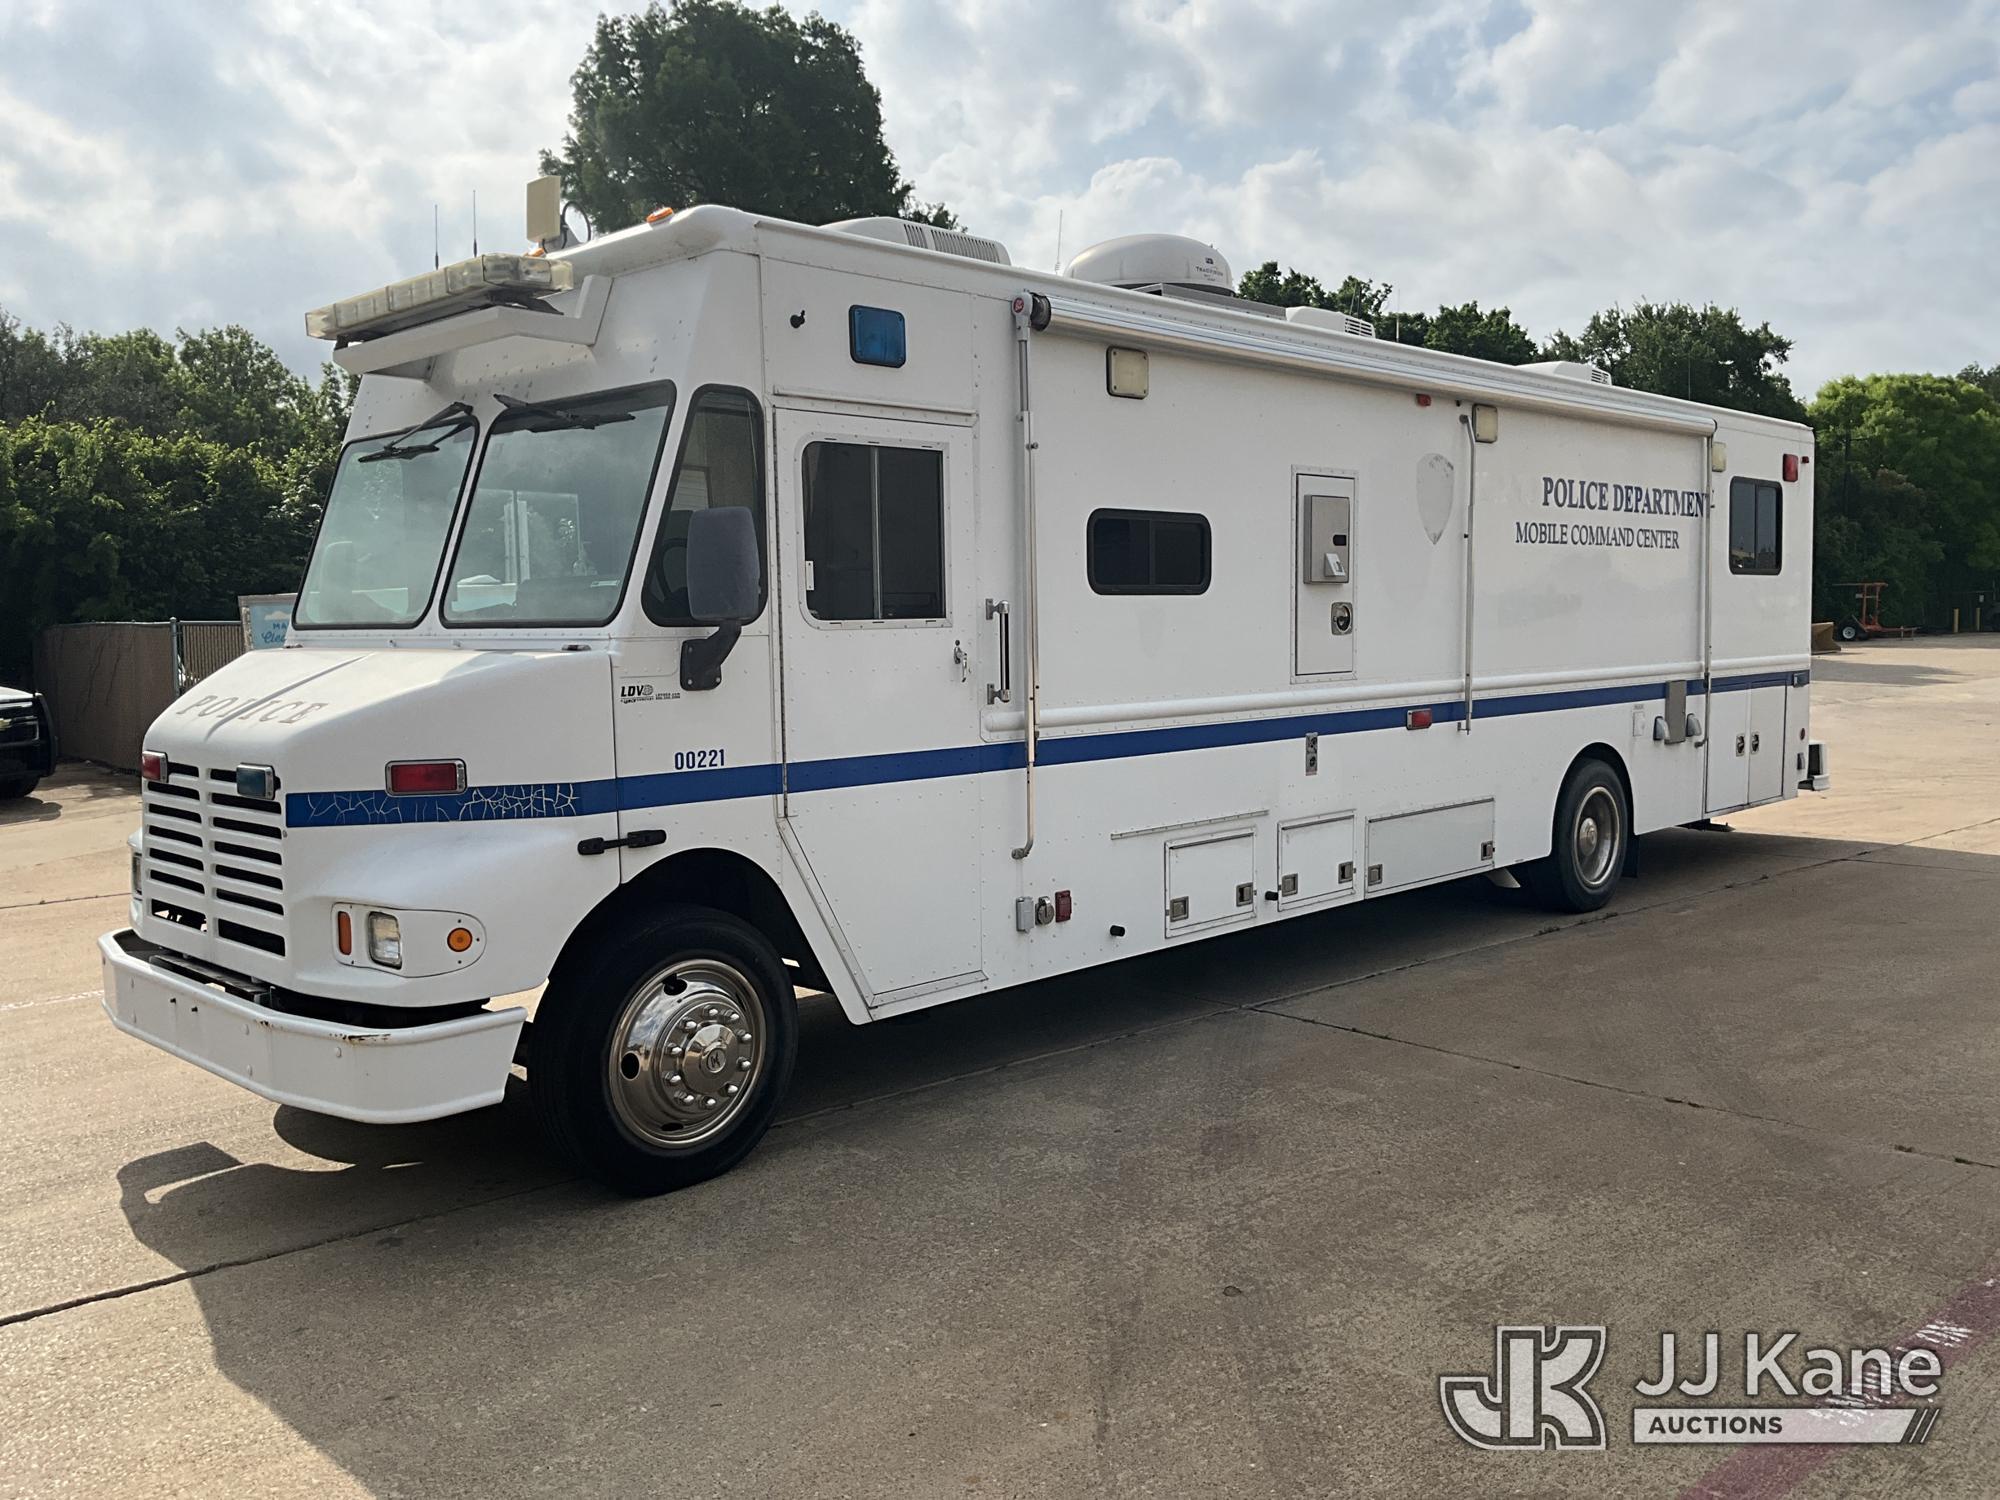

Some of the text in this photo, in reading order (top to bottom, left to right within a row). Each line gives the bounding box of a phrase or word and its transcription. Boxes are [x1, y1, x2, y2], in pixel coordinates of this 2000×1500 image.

[1542, 477, 1608, 510] POLICE
[1515, 522, 1680, 549] MOBILE COMMAND CENTER
[620, 685, 644, 697] LDV
[176, 695, 328, 723] POLICE
[674, 749, 724, 770] 00221
